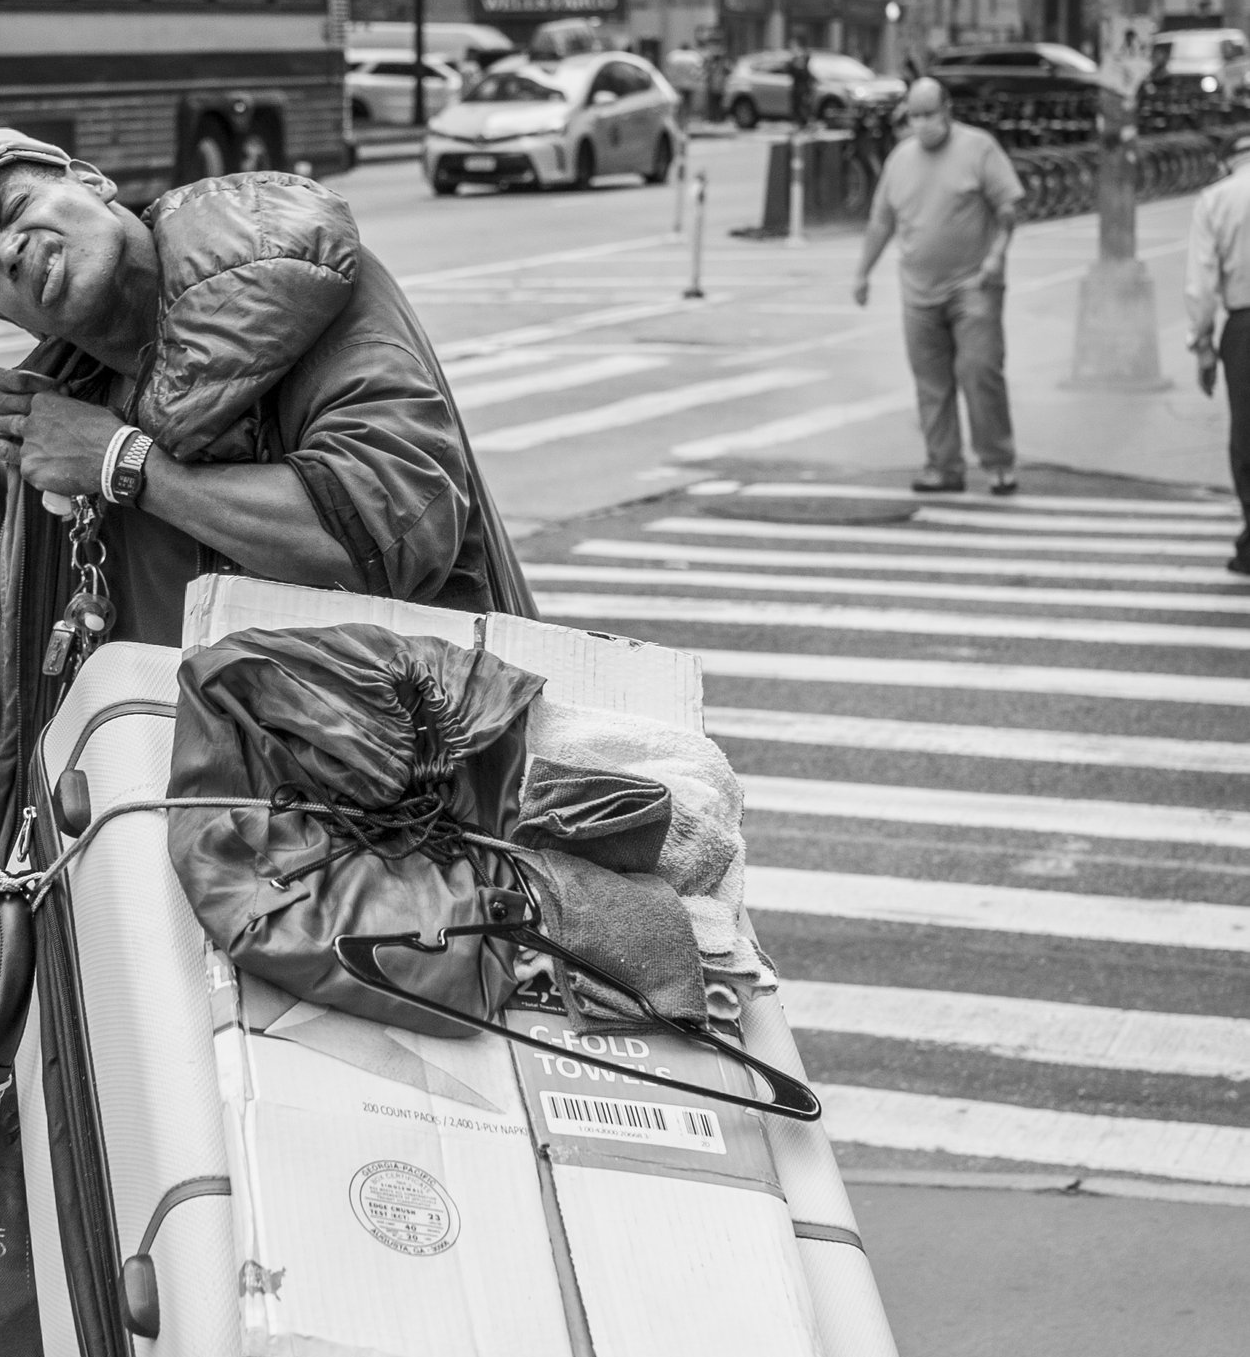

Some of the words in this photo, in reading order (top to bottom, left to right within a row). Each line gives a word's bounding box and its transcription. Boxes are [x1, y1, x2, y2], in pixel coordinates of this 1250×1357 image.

[529, 1024, 650, 1059] C-FOLD
[362, 1101, 379, 1114] 200
[380, 1105, 411, 1120] COUNT
[449, 1116, 473, 1131] 2,400
